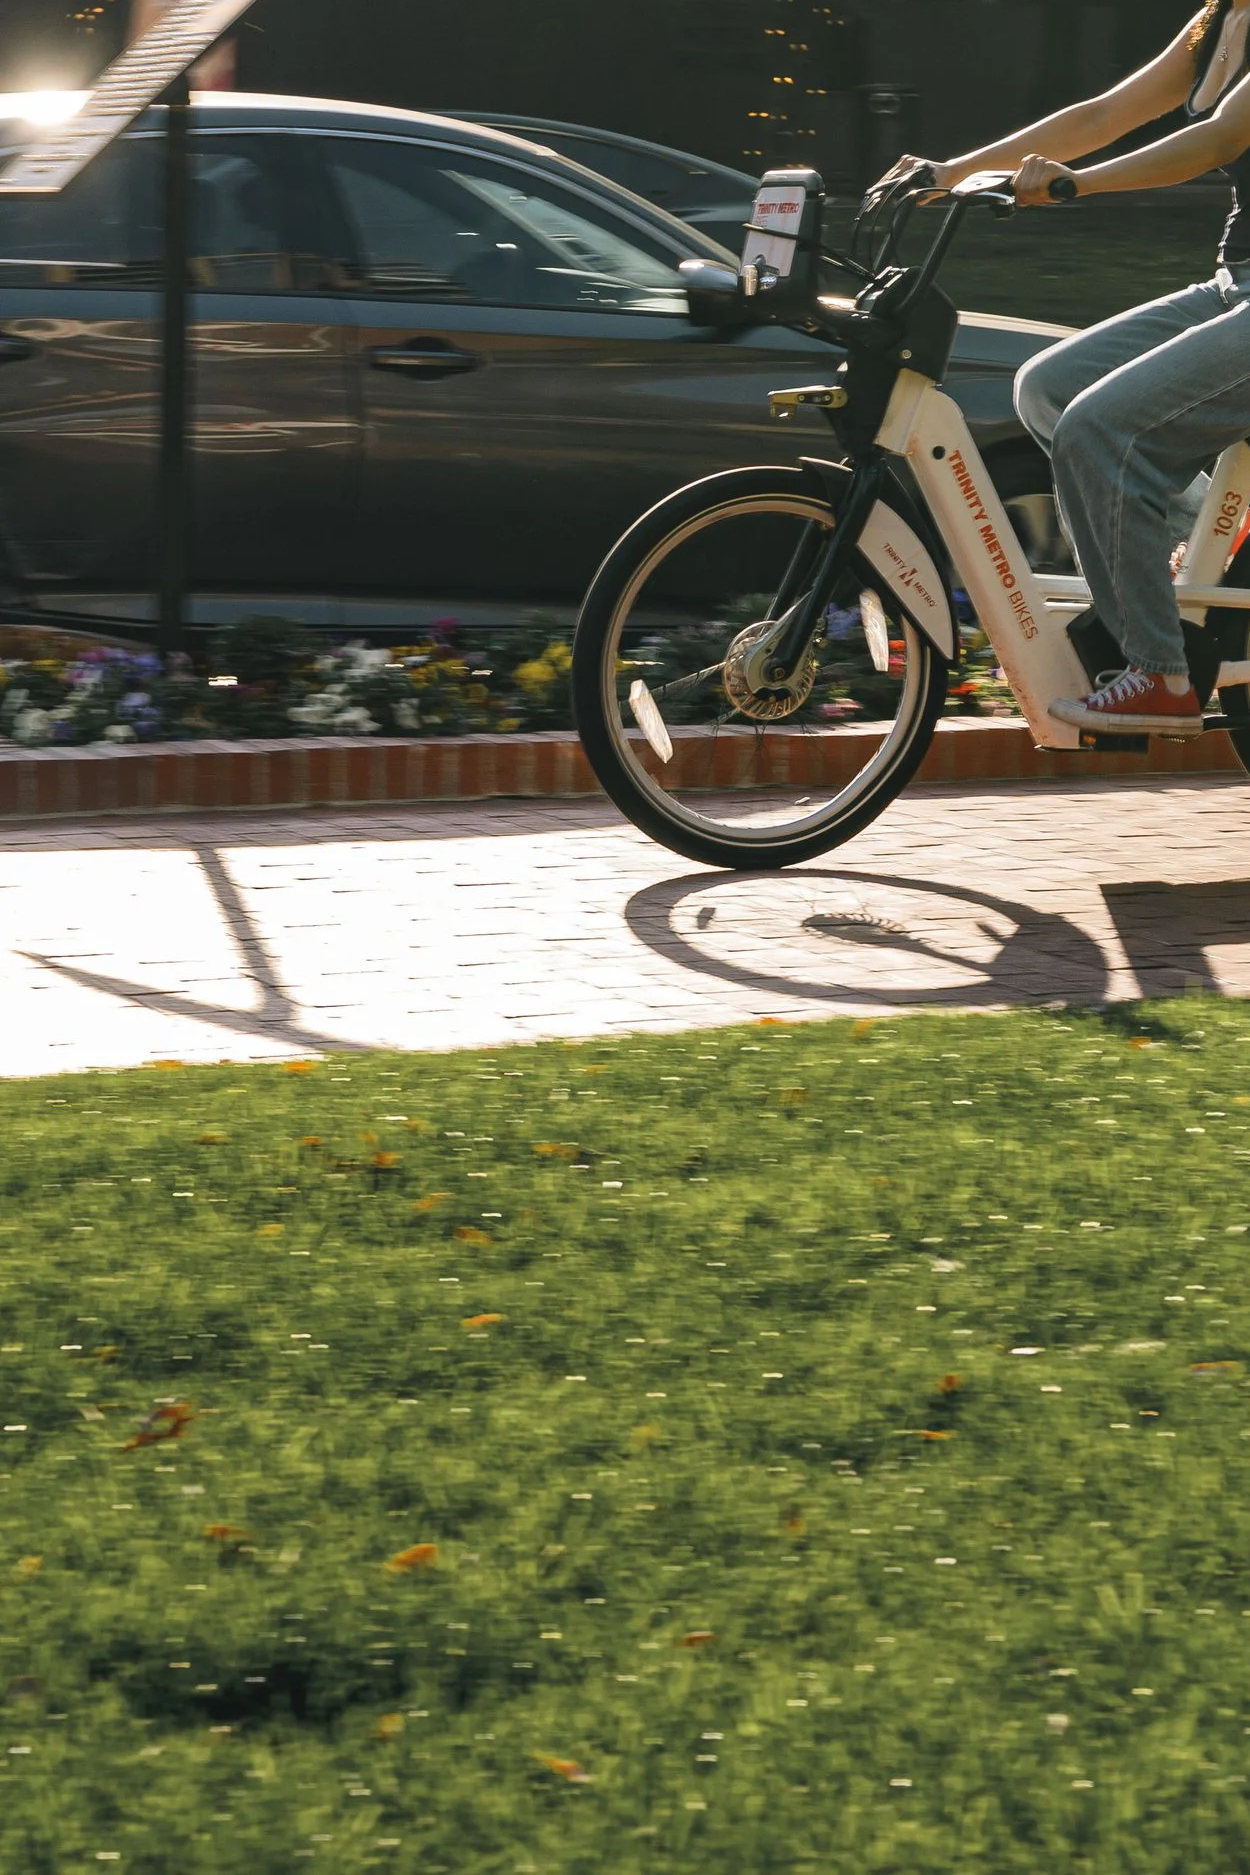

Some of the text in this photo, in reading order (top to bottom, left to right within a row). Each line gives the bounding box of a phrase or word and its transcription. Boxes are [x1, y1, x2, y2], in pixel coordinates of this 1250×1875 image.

[946, 450, 1038, 641] TRINITY METRO BIKES
[1213, 491, 1243, 537] 1063
[883, 542, 907, 569] TRINITY
[914, 581, 936, 607] METRO
